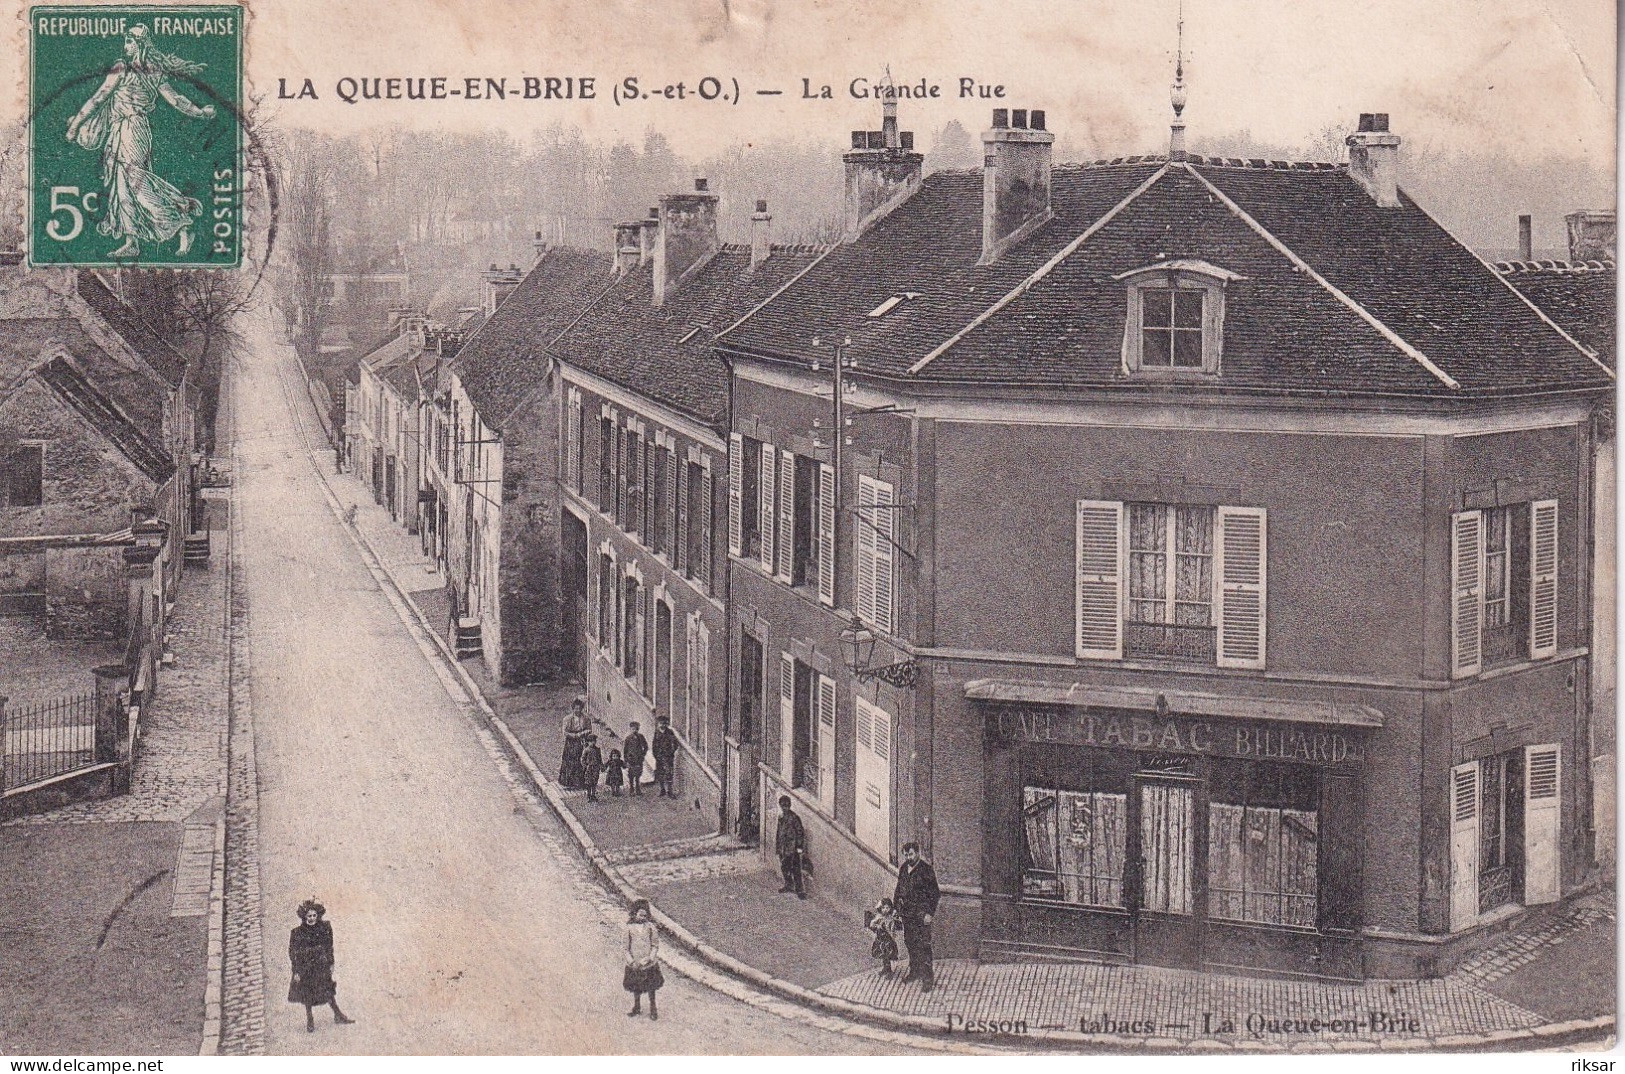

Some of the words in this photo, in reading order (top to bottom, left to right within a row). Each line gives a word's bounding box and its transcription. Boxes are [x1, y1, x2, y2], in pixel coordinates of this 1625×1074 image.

[154, 17, 234, 38] FRANÇAISE
[213, 168, 233, 253] POSTES
[1077, 713, 1212, 752] TABAC
[1235, 726, 1348, 763] BILLARD
